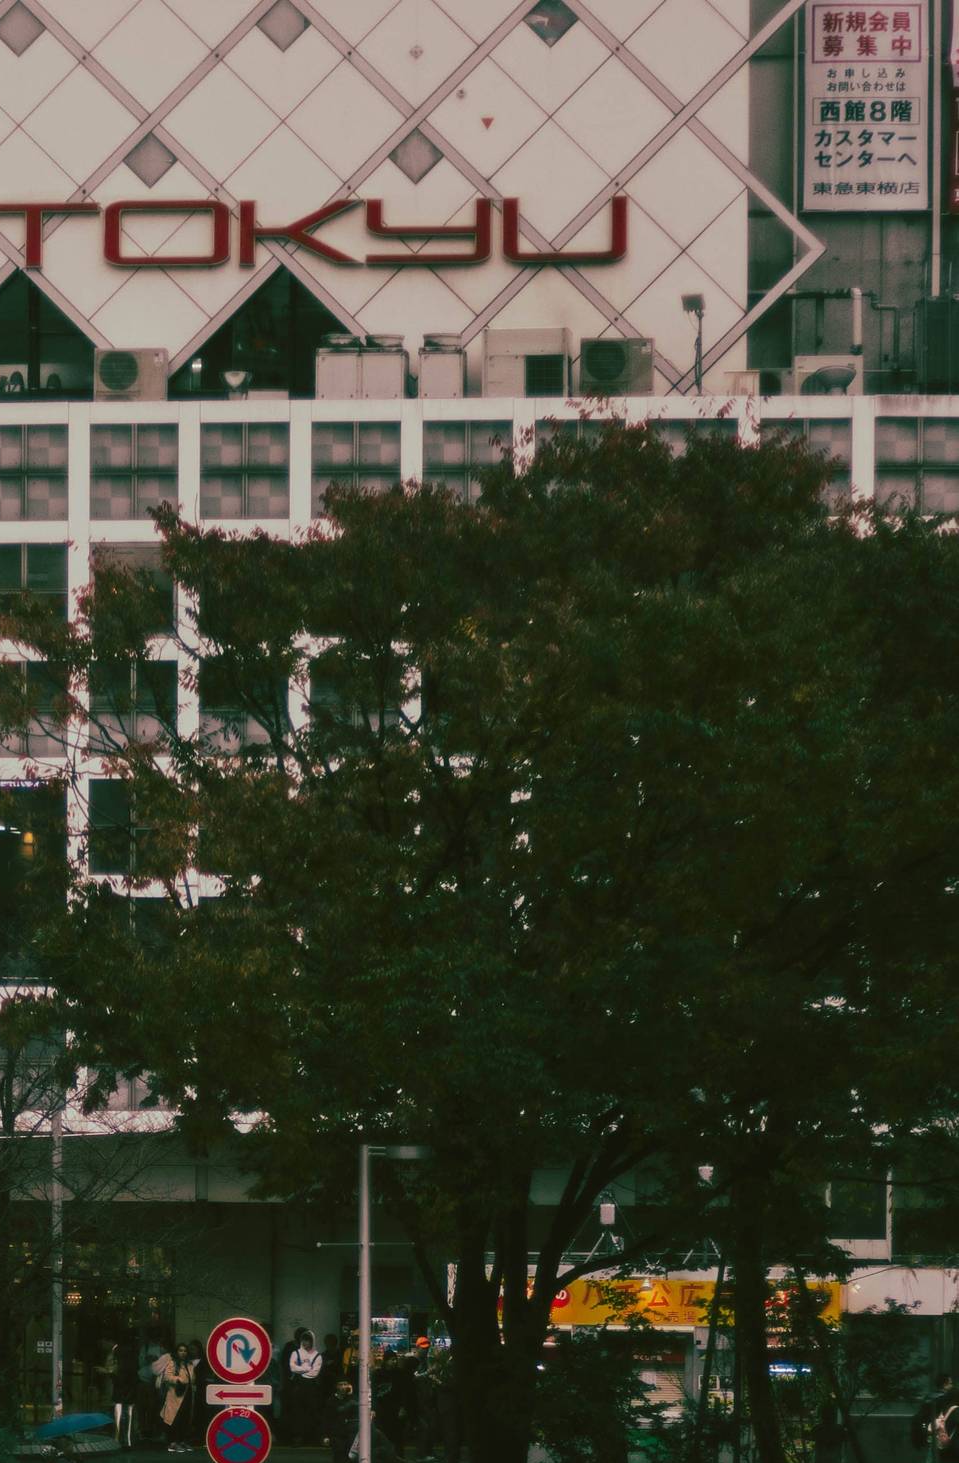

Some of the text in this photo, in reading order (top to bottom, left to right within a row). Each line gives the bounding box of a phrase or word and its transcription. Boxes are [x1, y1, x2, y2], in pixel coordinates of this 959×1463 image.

[823, 11, 911, 33] 新規会員
[823, 35, 912, 57] 募集中
[827, 68, 906, 79] お申し込み
[827, 81, 906, 92] お問い合わせは
[820, 101, 912, 122] 西館8階
[814, 129, 917, 147] カスタマー
[814, 150, 917, 168] センターへ
[812, 181, 920, 195] 東急東横店
